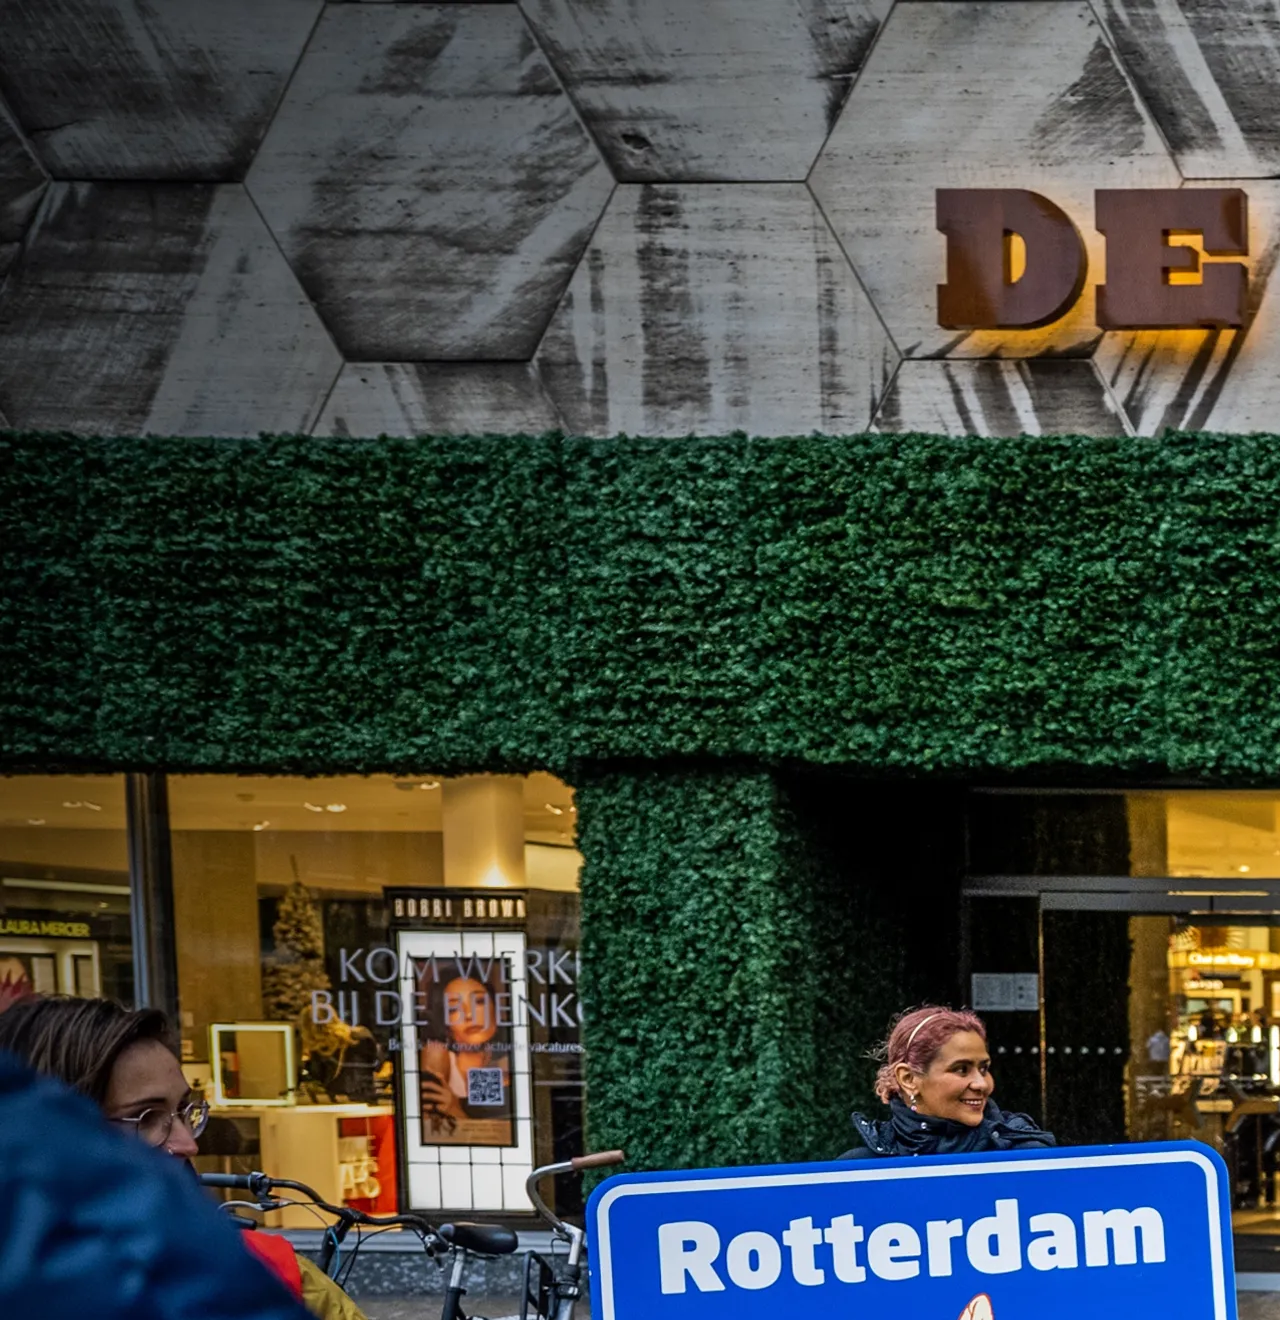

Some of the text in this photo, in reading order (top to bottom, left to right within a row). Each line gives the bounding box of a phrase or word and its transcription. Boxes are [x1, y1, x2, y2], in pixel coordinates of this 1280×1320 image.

[936, 187, 1249, 332] DE
[340, 947, 582, 986] KOM WERK
[311, 990, 359, 1029] BIJ
[376, 990, 429, 1026] DE
[657, 1198, 1167, 1296] Rotterdam
